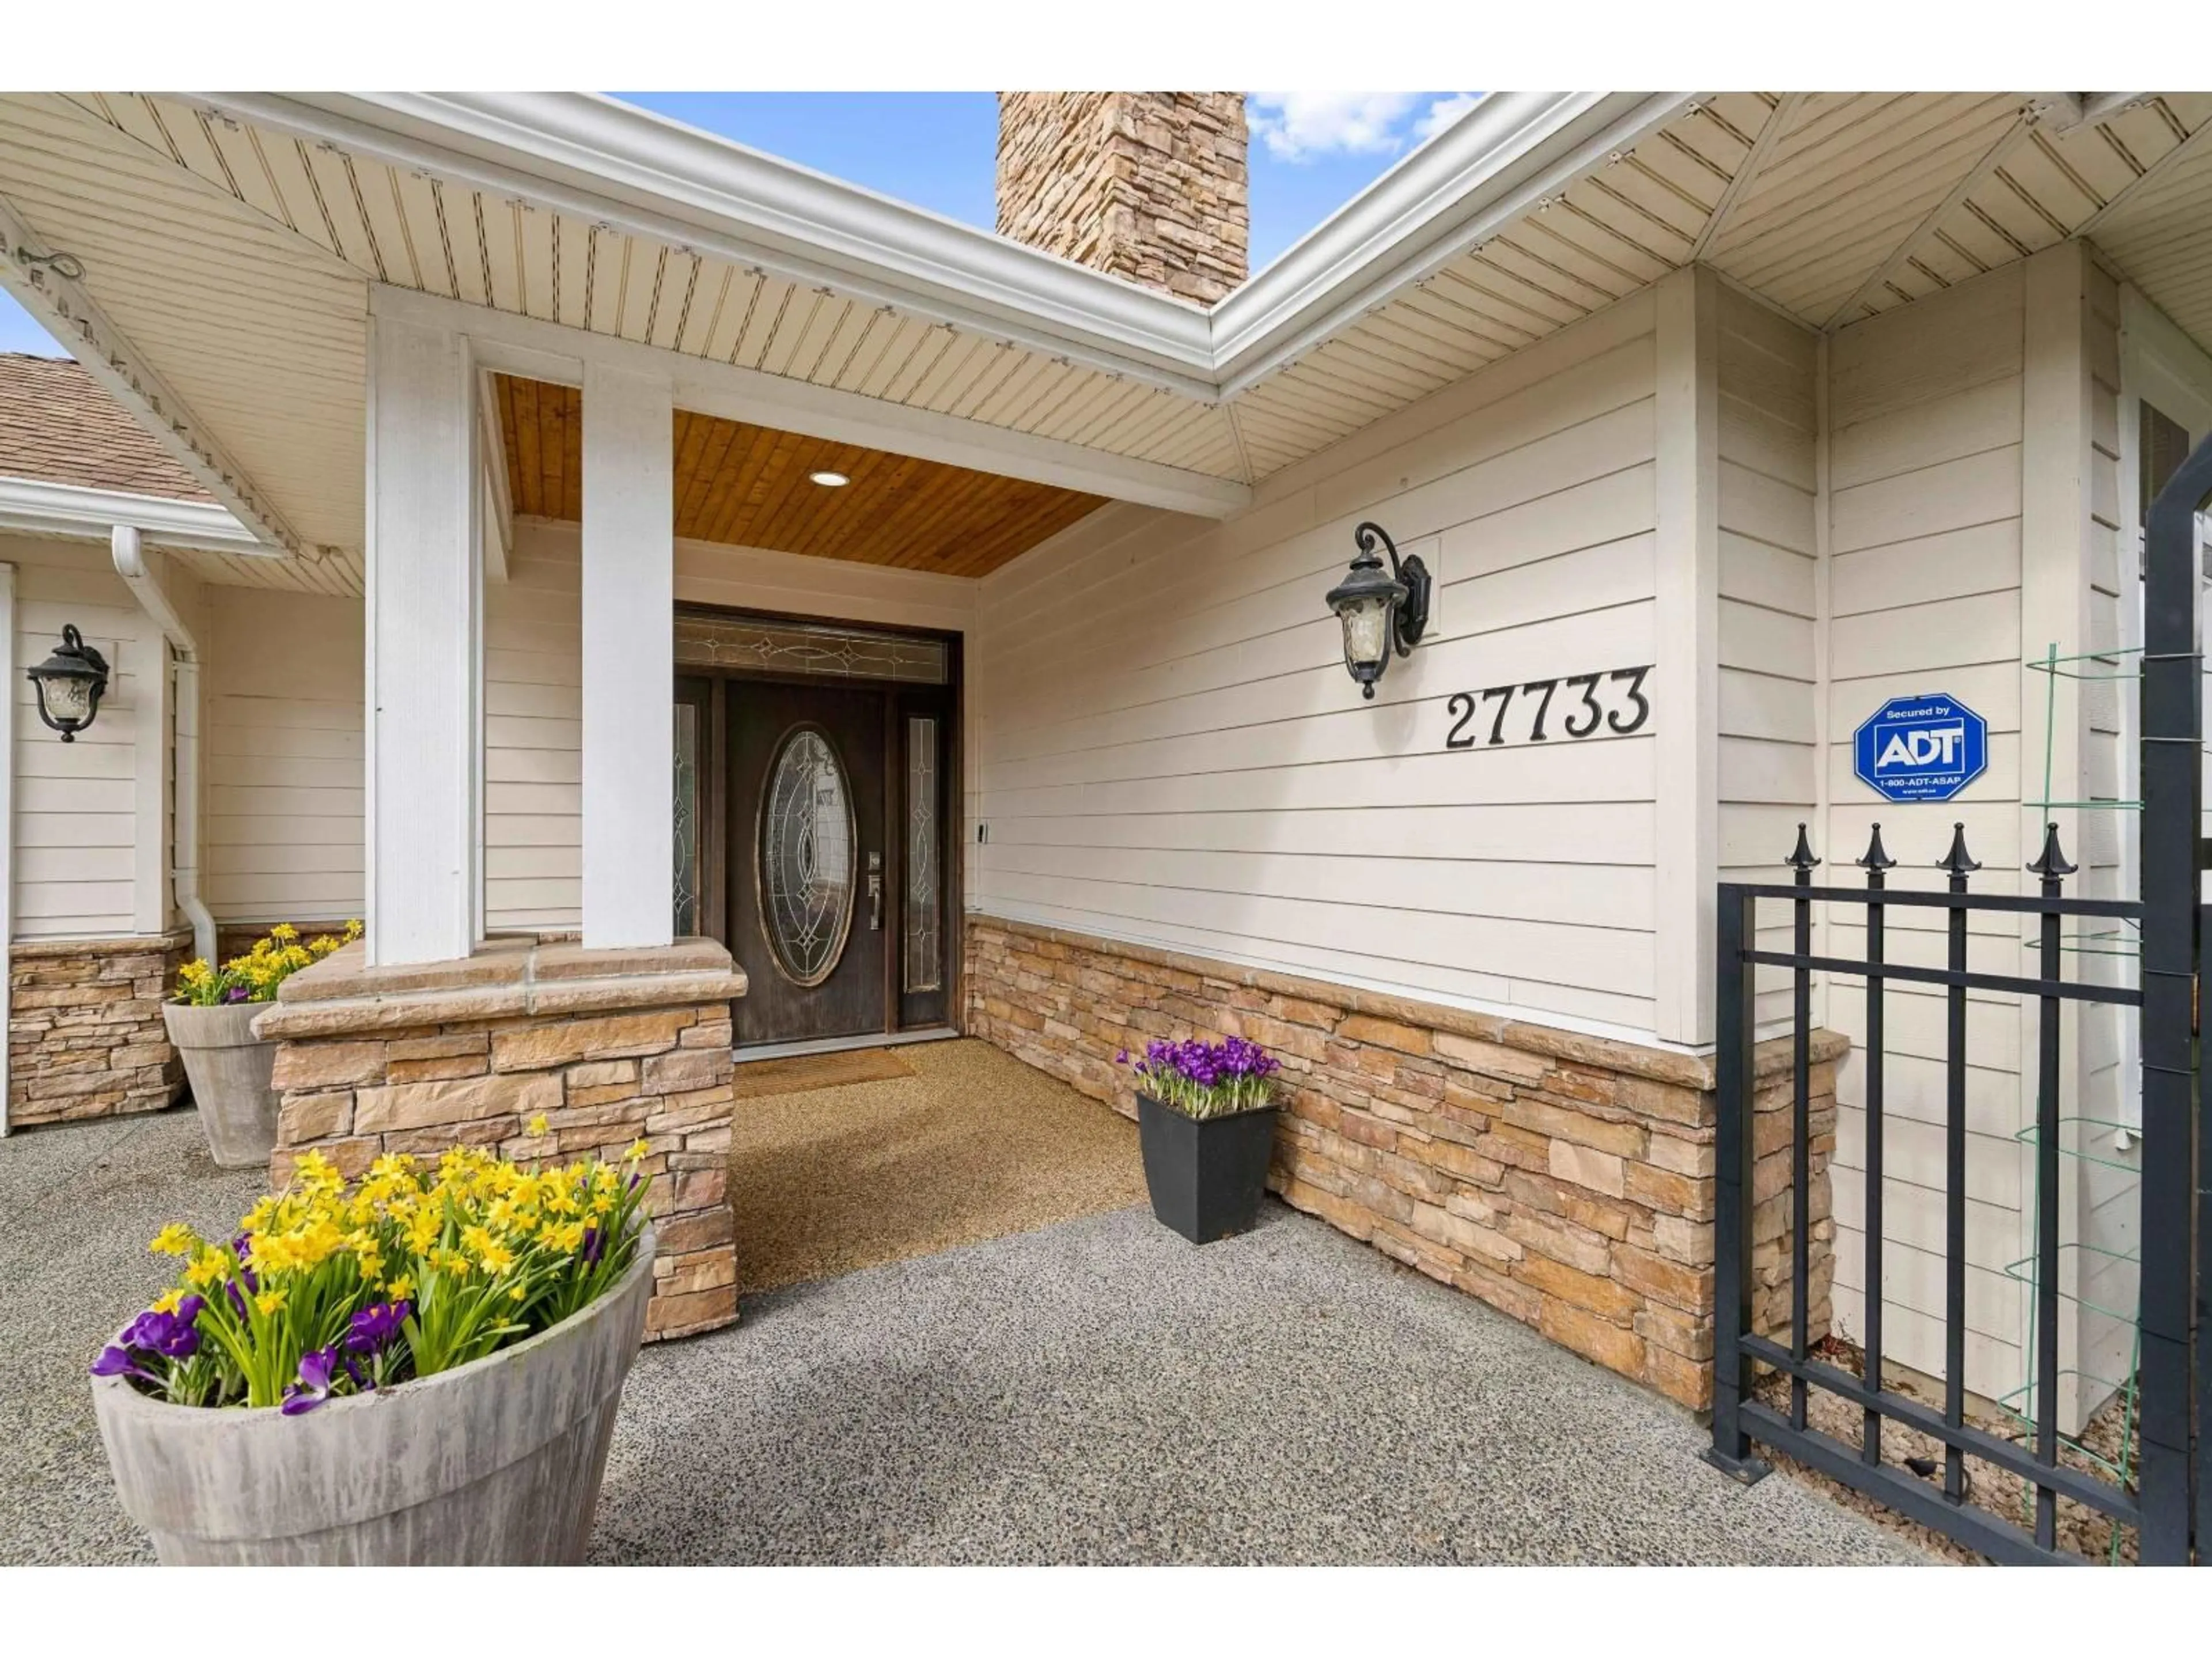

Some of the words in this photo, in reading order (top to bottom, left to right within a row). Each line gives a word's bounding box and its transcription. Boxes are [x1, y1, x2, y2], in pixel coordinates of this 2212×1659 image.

[1446, 665, 1649, 748] 27733
[1887, 709, 1933, 719] Secured
[1936, 706, 1950, 716] by
[1876, 728, 1963, 767] ADT
[1880, 777, 1961, 787] 1-800-ADT-ASAP
